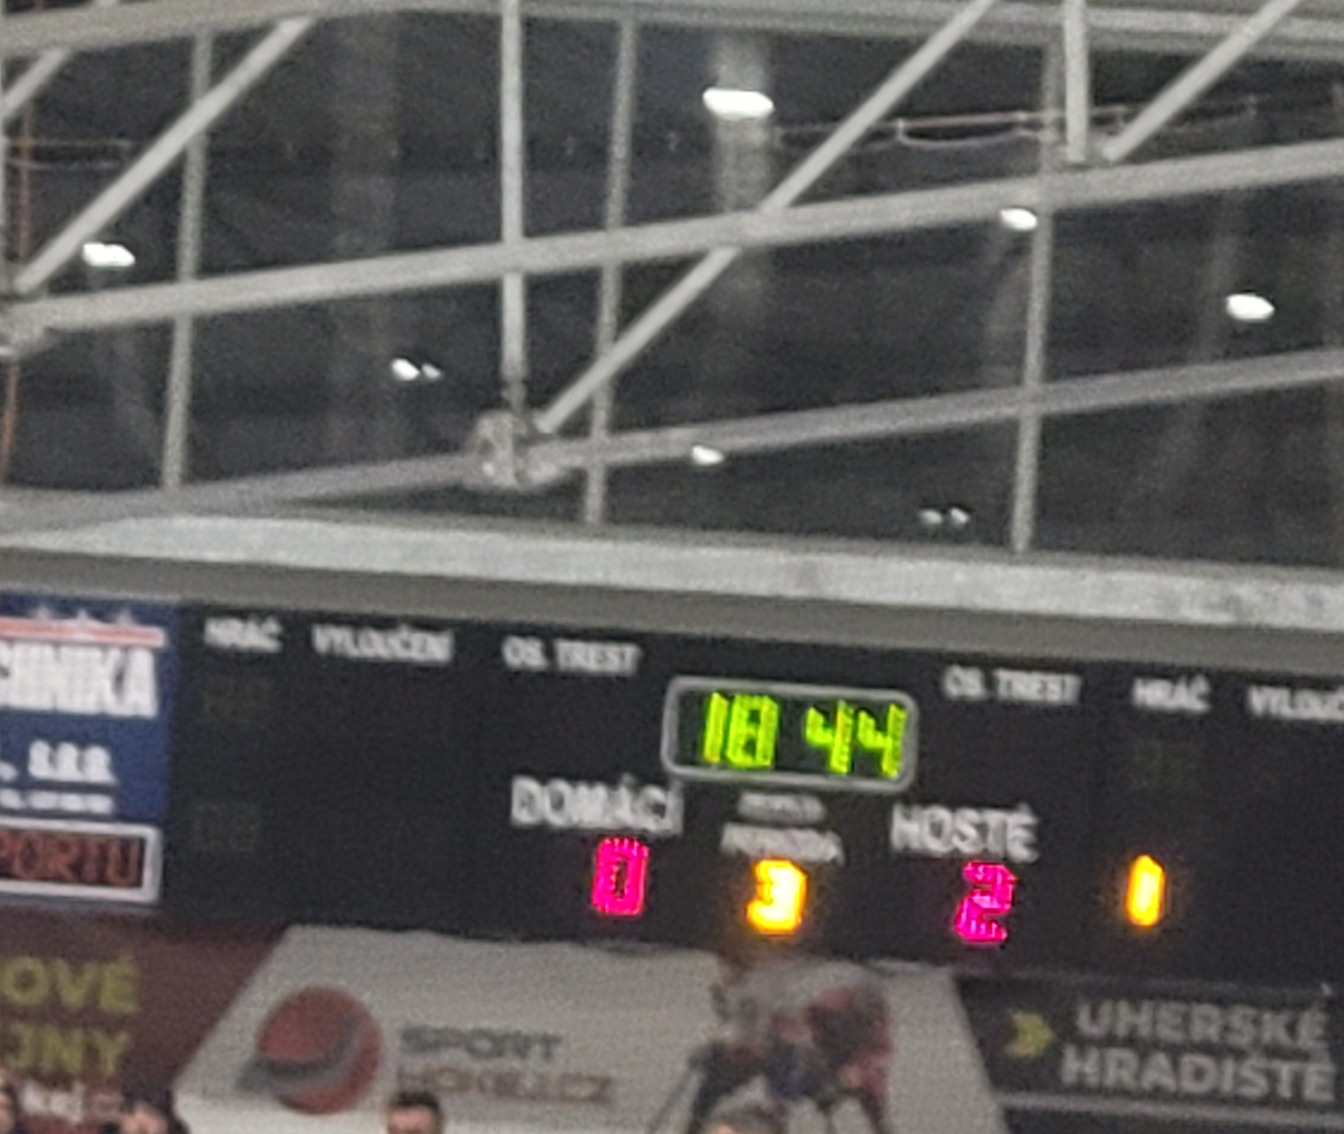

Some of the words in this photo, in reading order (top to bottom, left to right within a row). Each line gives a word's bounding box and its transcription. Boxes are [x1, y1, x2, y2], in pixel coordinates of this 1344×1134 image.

[511, 774, 684, 835] DOMÁCÍ
[890, 803, 1041, 863] HOSTÉ
[592, 837, 650, 917] 0
[747, 859, 806, 934] 3
[957, 861, 1017, 942] 2
[1076, 998, 1329, 1051] UHERSKÉ
